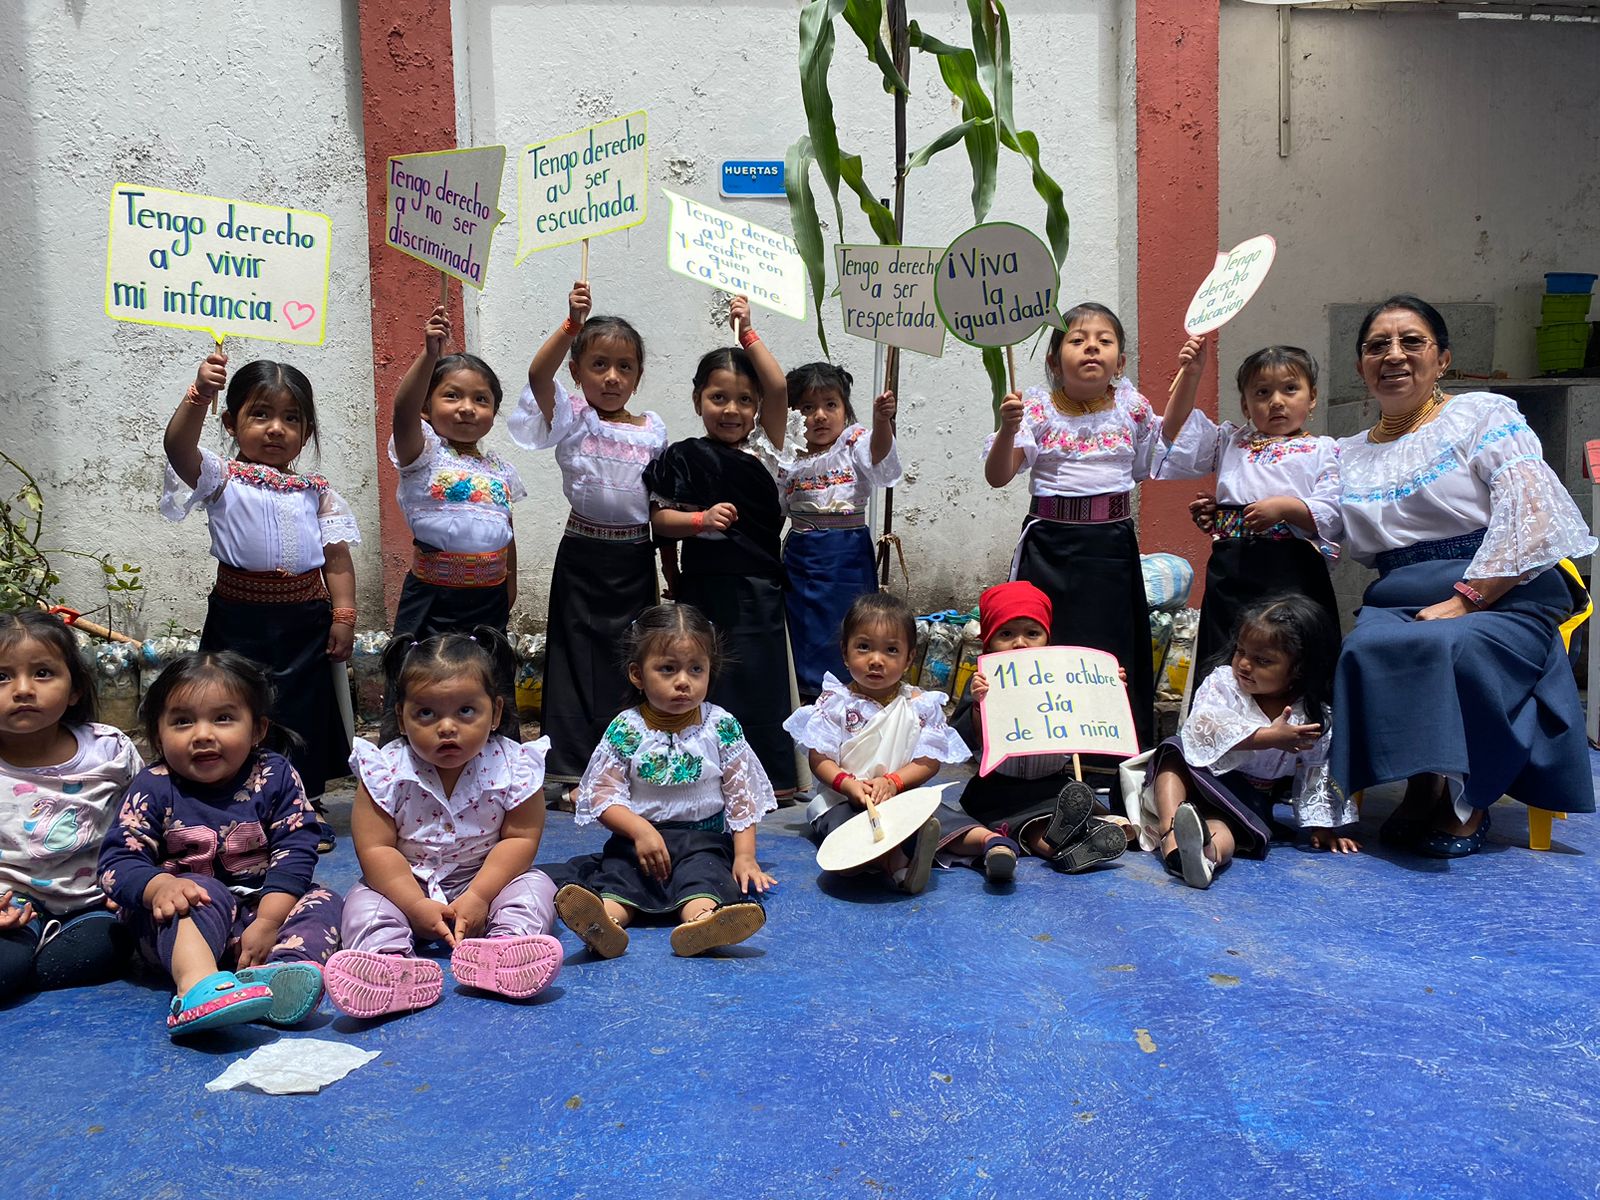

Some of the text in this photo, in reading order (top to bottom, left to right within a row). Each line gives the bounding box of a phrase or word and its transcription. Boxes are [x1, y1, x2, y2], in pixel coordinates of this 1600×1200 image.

[528, 119, 645, 195] Tengo derecho
[724, 166, 779, 175] HUERTAS
[390, 159, 490, 220] Tengo derecho
[546, 168, 610, 203] a ser
[395, 194, 477, 236] a no ser
[536, 180, 639, 233] escuchada.
[118, 191, 315, 256] Tengo derecho
[680, 198, 800, 256] Tengo derecho
[692, 233, 746, 260] decidir
[758, 261, 783, 277] con
[702, 228, 778, 260] a crecer
[149, 248, 266, 278] a vivir
[708, 254, 750, 274] quien
[840, 248, 879, 291] Tengo
[948, 247, 1018, 279] ¡Viva
[1223, 249, 1262, 275] Tengo
[871, 282, 919, 300] a ser
[982, 280, 1004, 306] la
[1198, 270, 1249, 299] derecho
[1206, 288, 1235, 307] a la
[113, 281, 278, 322] mi infancia.
[954, 288, 1052, 341] igualdad!
[1187, 295, 1243, 328] educación
[994, 658, 1118, 689] 11 de octubre
[1037, 691, 1073, 713] día
[1005, 715, 1120, 742] de la niña
